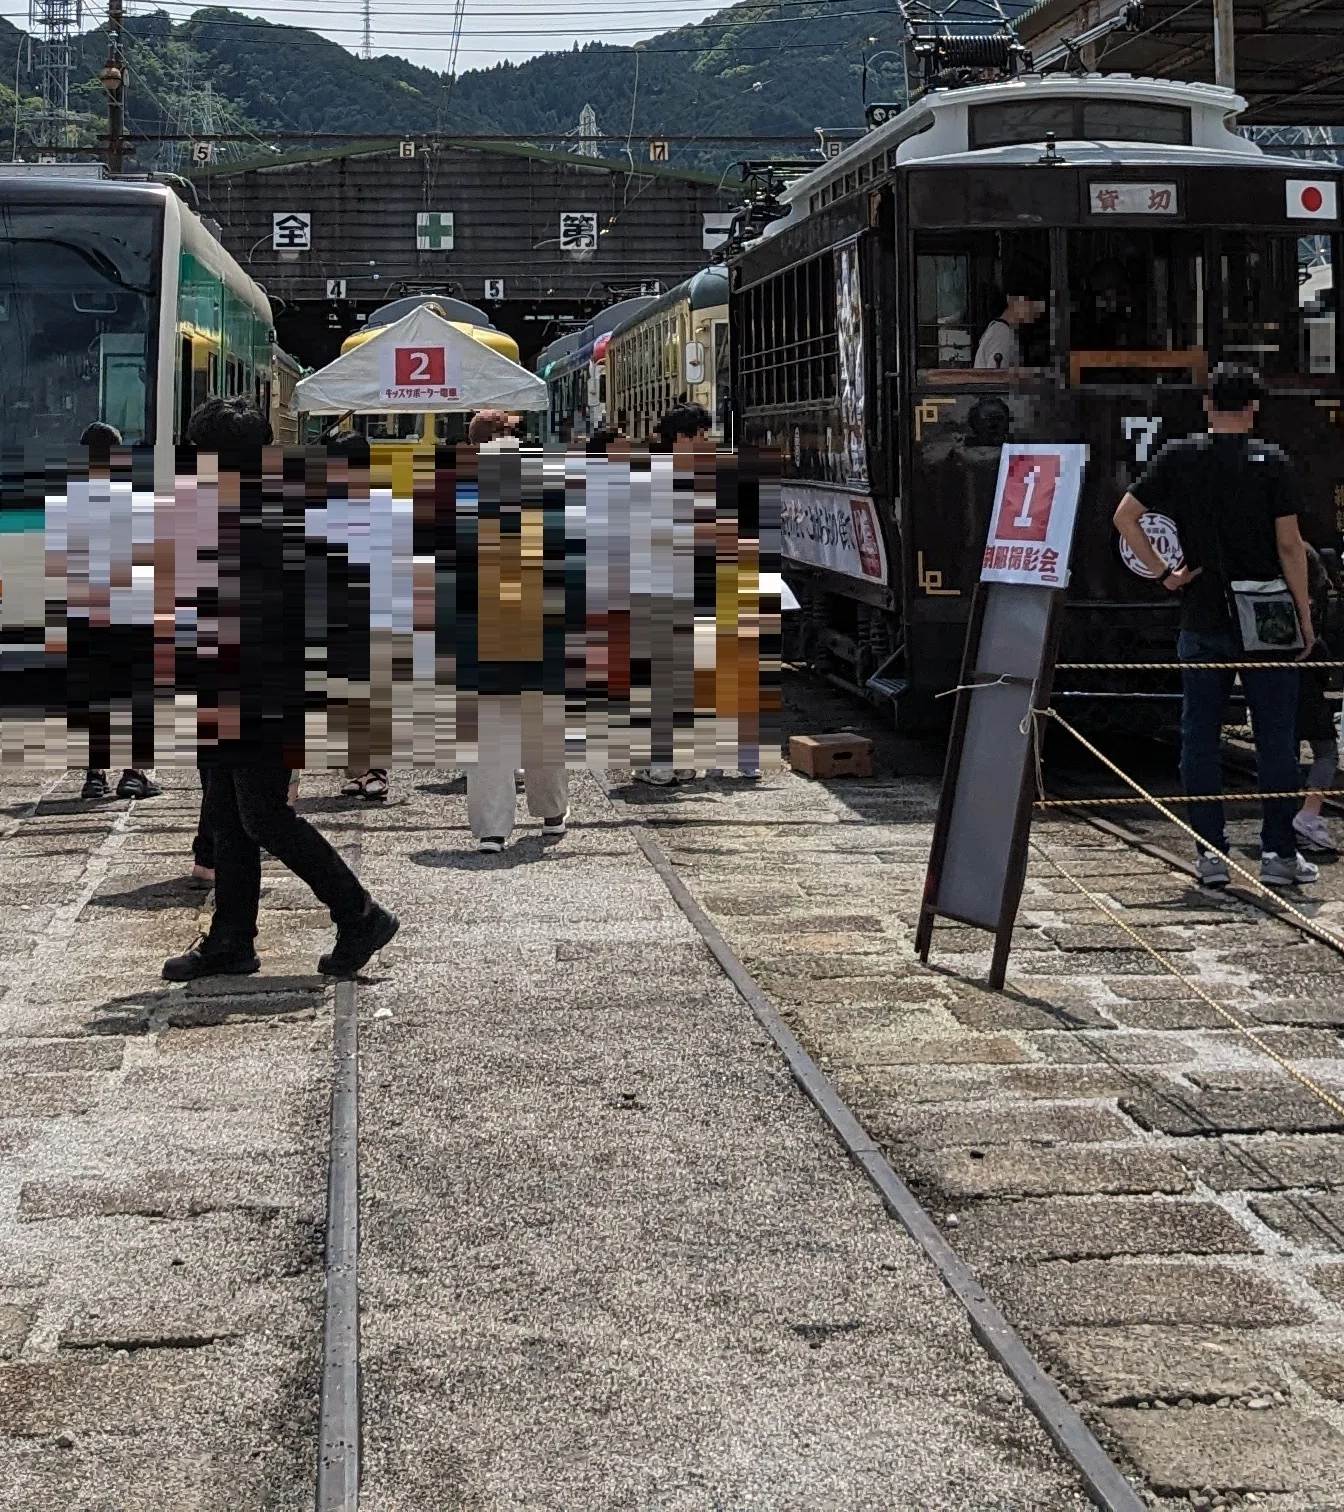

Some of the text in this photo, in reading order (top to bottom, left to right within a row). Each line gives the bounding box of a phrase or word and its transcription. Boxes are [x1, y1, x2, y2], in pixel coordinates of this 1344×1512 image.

[197, 146, 209, 160] 5
[402, 143, 412, 158] 6
[653, 144, 665, 160] 7
[275, 214, 309, 247] 全
[562, 214, 595, 248] 第
[329, 281, 342, 298] 4
[489, 282, 500, 297] 5
[409, 352, 431, 381] 2
[1013, 466, 1041, 527] 1
